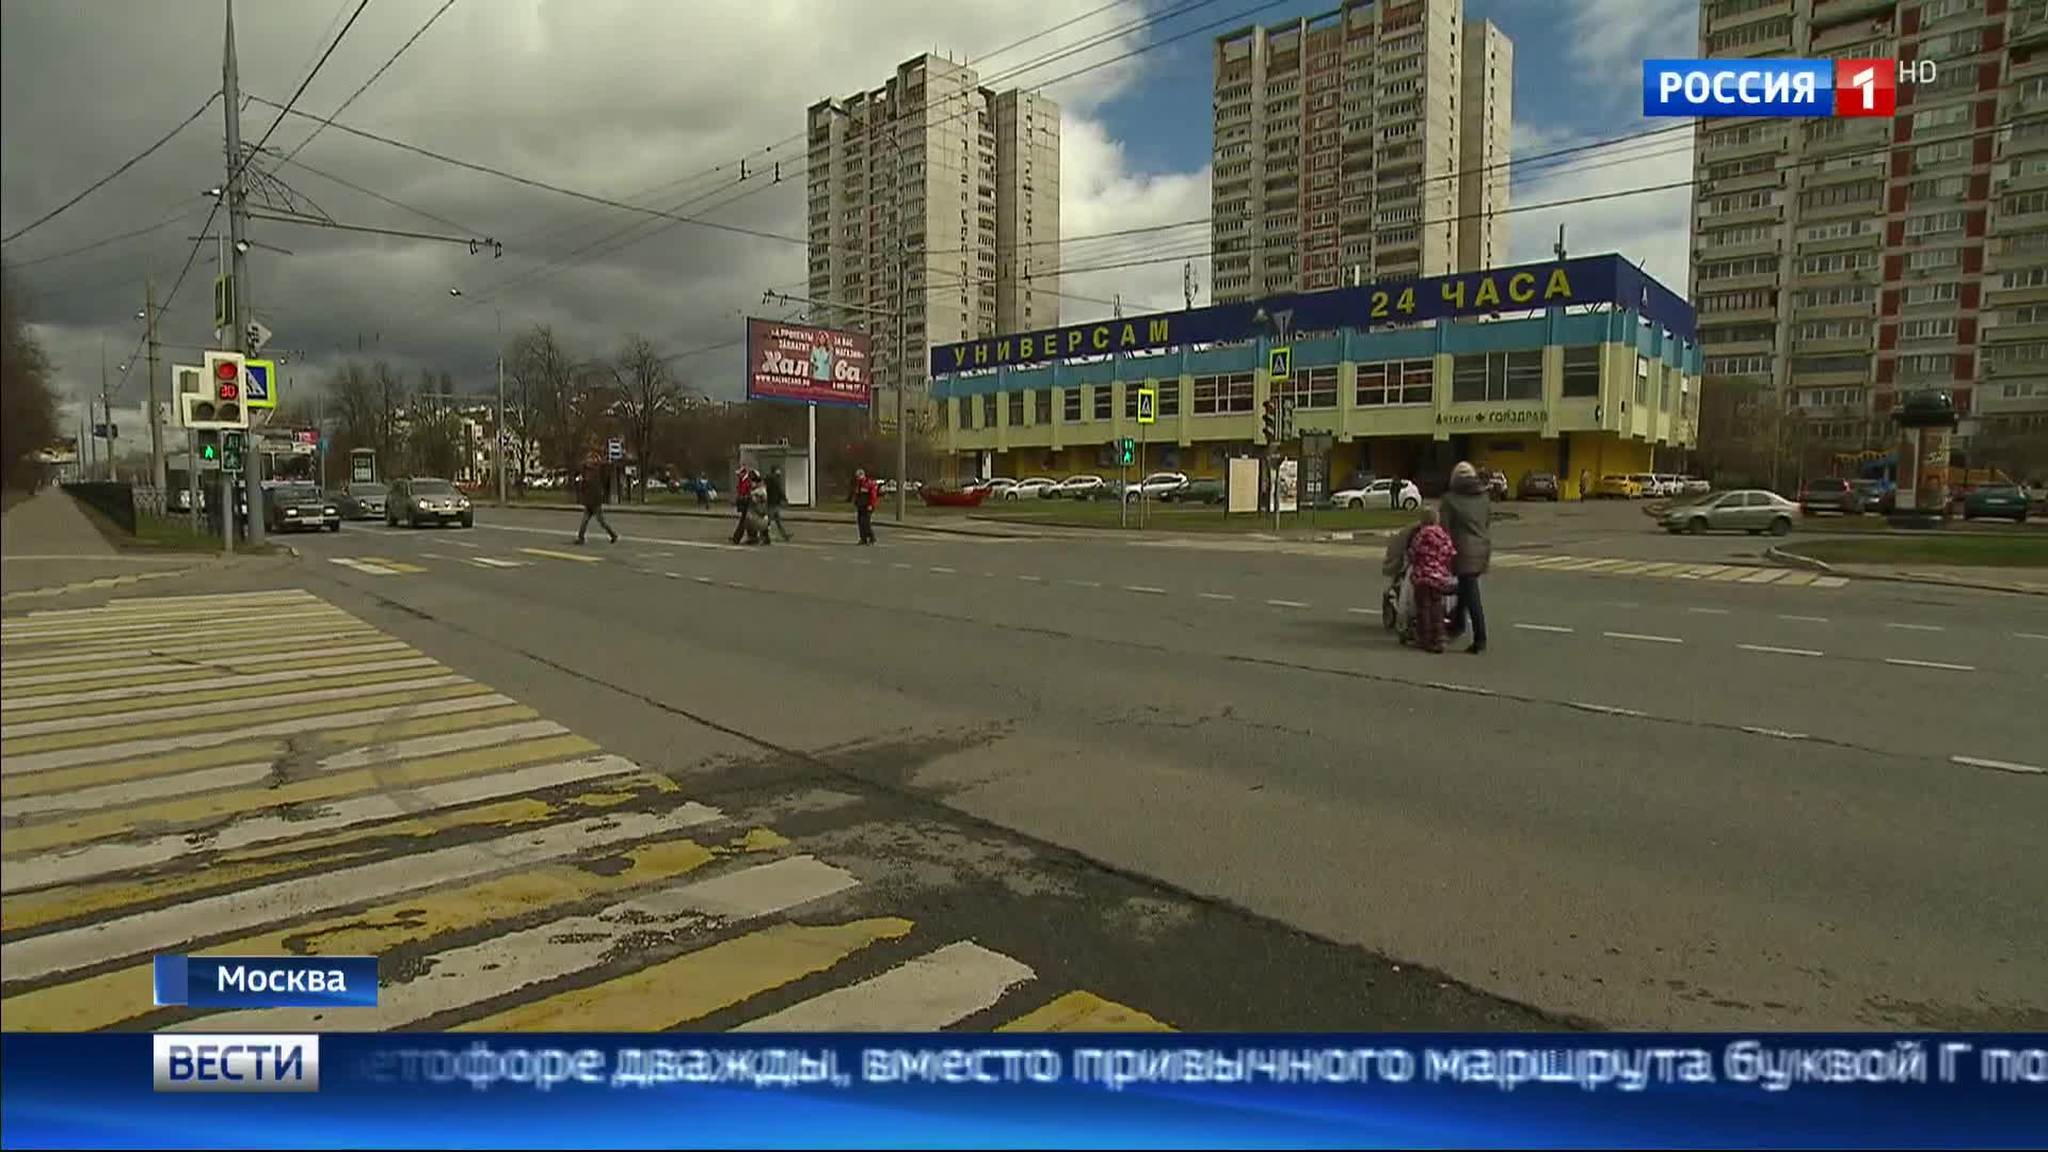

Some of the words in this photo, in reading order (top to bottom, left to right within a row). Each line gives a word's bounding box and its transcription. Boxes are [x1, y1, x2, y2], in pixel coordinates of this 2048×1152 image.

[1370, 287, 1416, 318] 24
[1441, 268, 1573, 309] ЧАСА
[954, 319, 1169, 367] УНИВЕРСАМ
